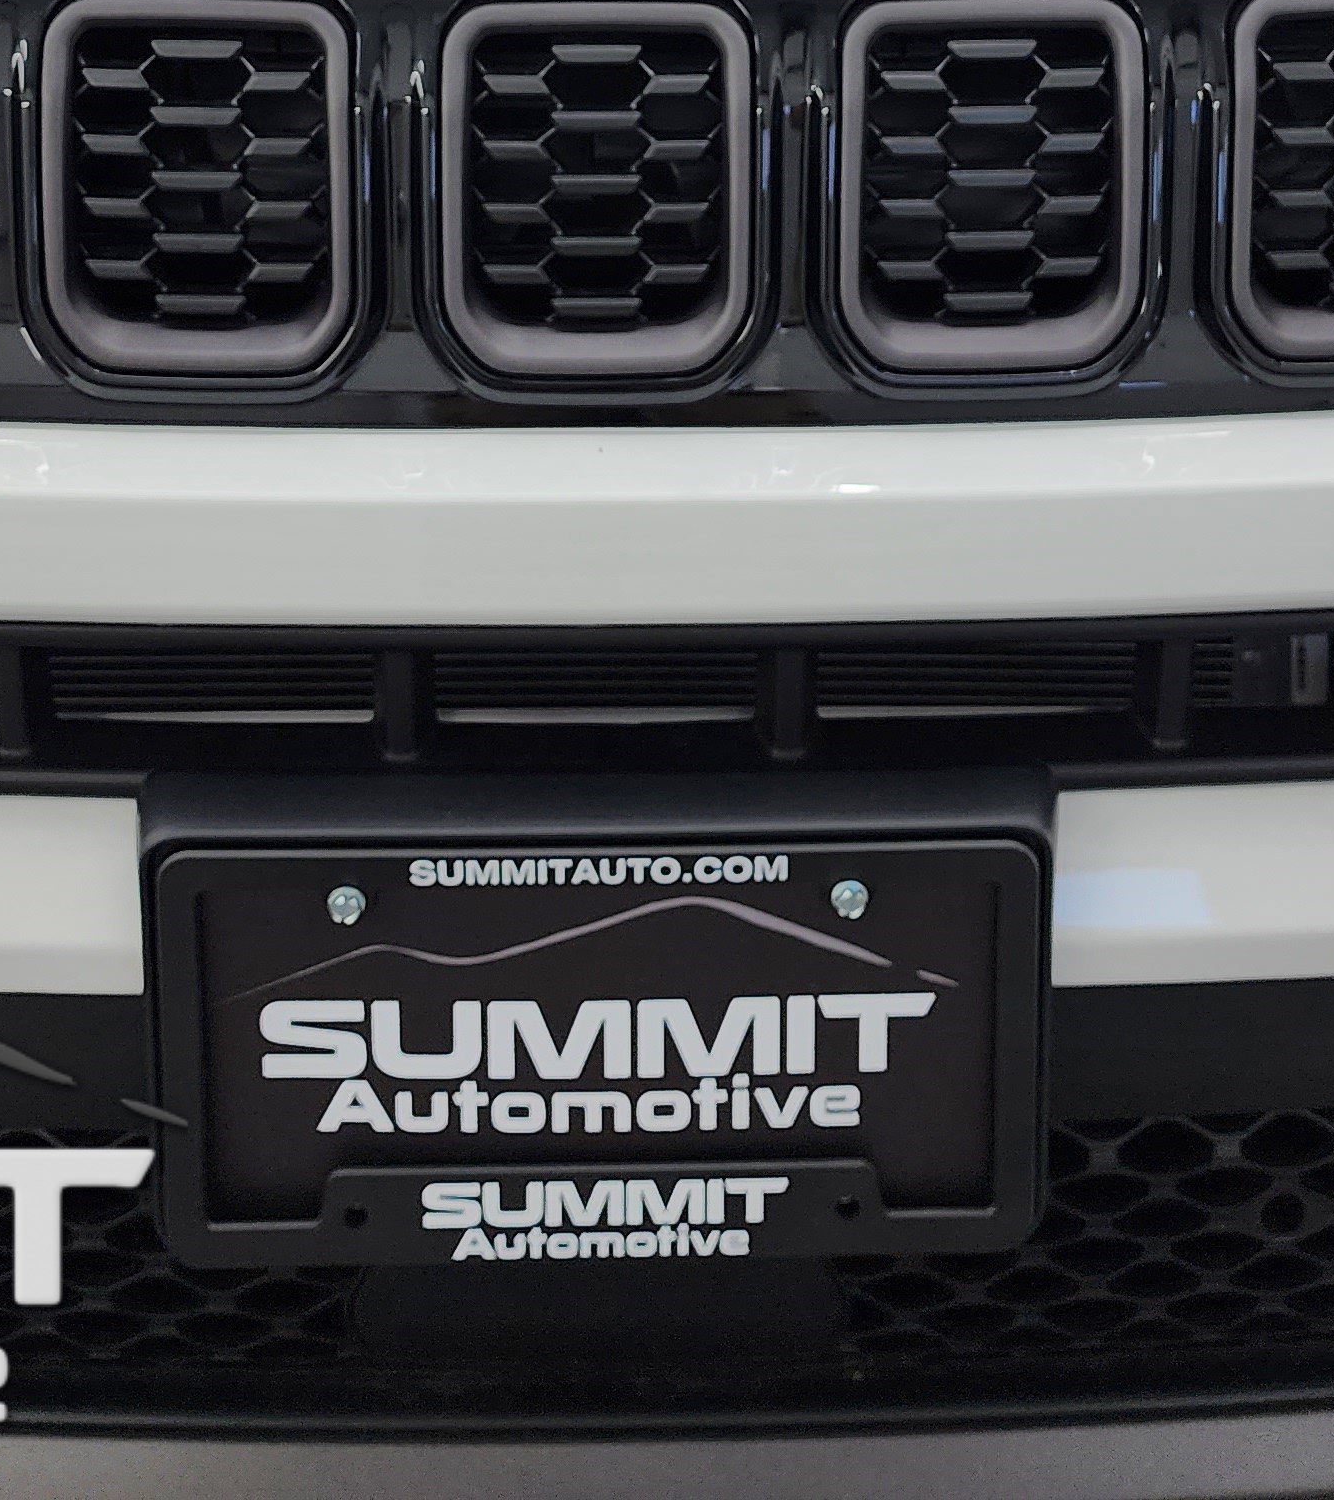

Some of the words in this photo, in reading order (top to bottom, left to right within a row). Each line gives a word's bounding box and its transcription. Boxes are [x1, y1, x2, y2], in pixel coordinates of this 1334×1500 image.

[407, 853, 790, 888] SUMMITAUTO.COM
[257, 990, 939, 1082] SUMMIT
[315, 1071, 862, 1135] Automotive
[420, 1175, 791, 1230] SUMMIT
[451, 1222, 751, 1262] Automotive
